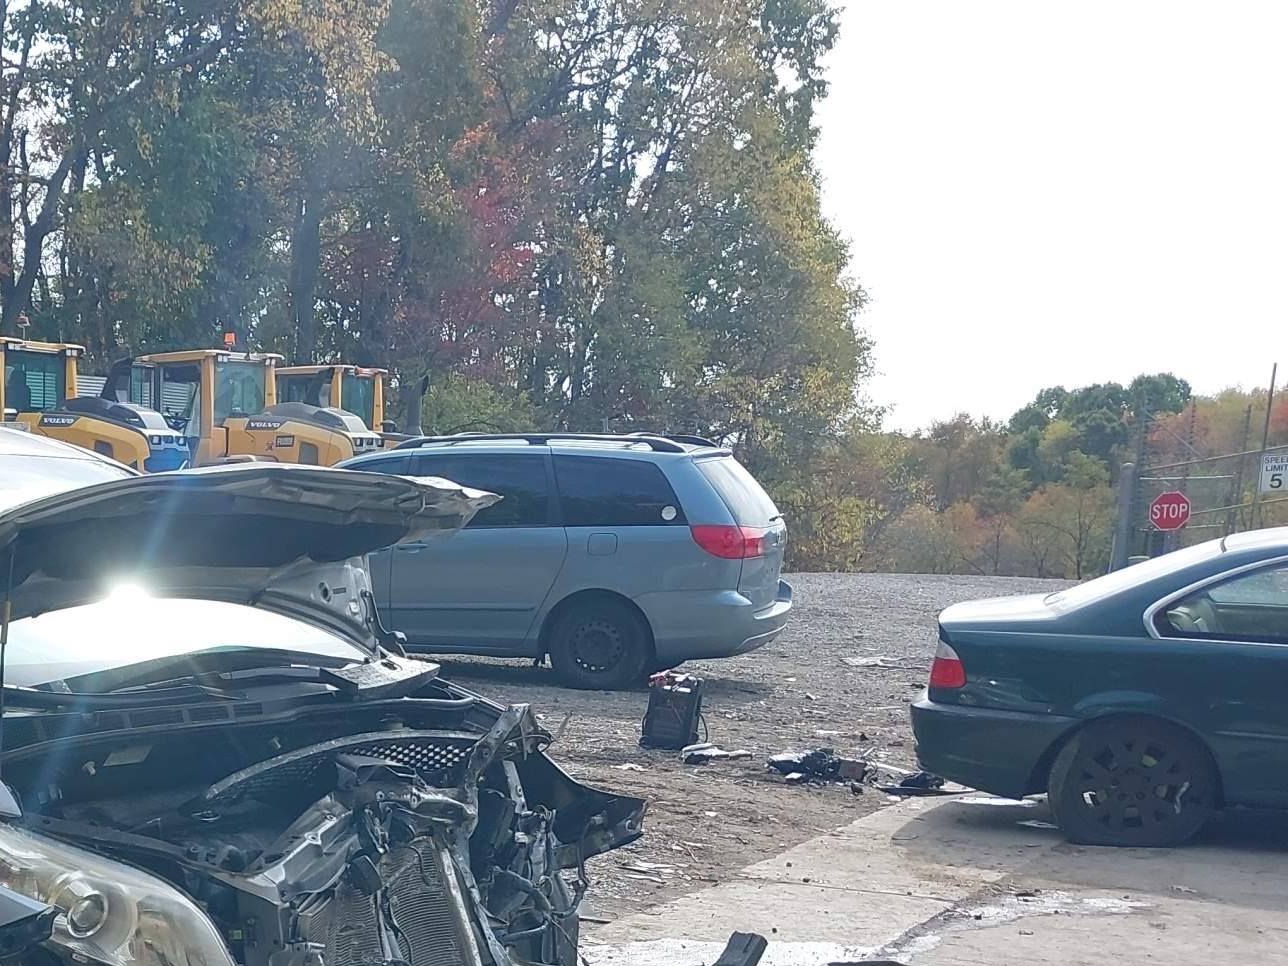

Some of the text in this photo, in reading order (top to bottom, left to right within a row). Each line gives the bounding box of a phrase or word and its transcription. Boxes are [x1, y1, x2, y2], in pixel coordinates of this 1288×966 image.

[1264, 456, 1288, 464] SPEE
[1265, 464, 1288, 472] LIMIT
[1270, 473, 1283, 488] 5
[1152, 503, 1188, 520] STOP
